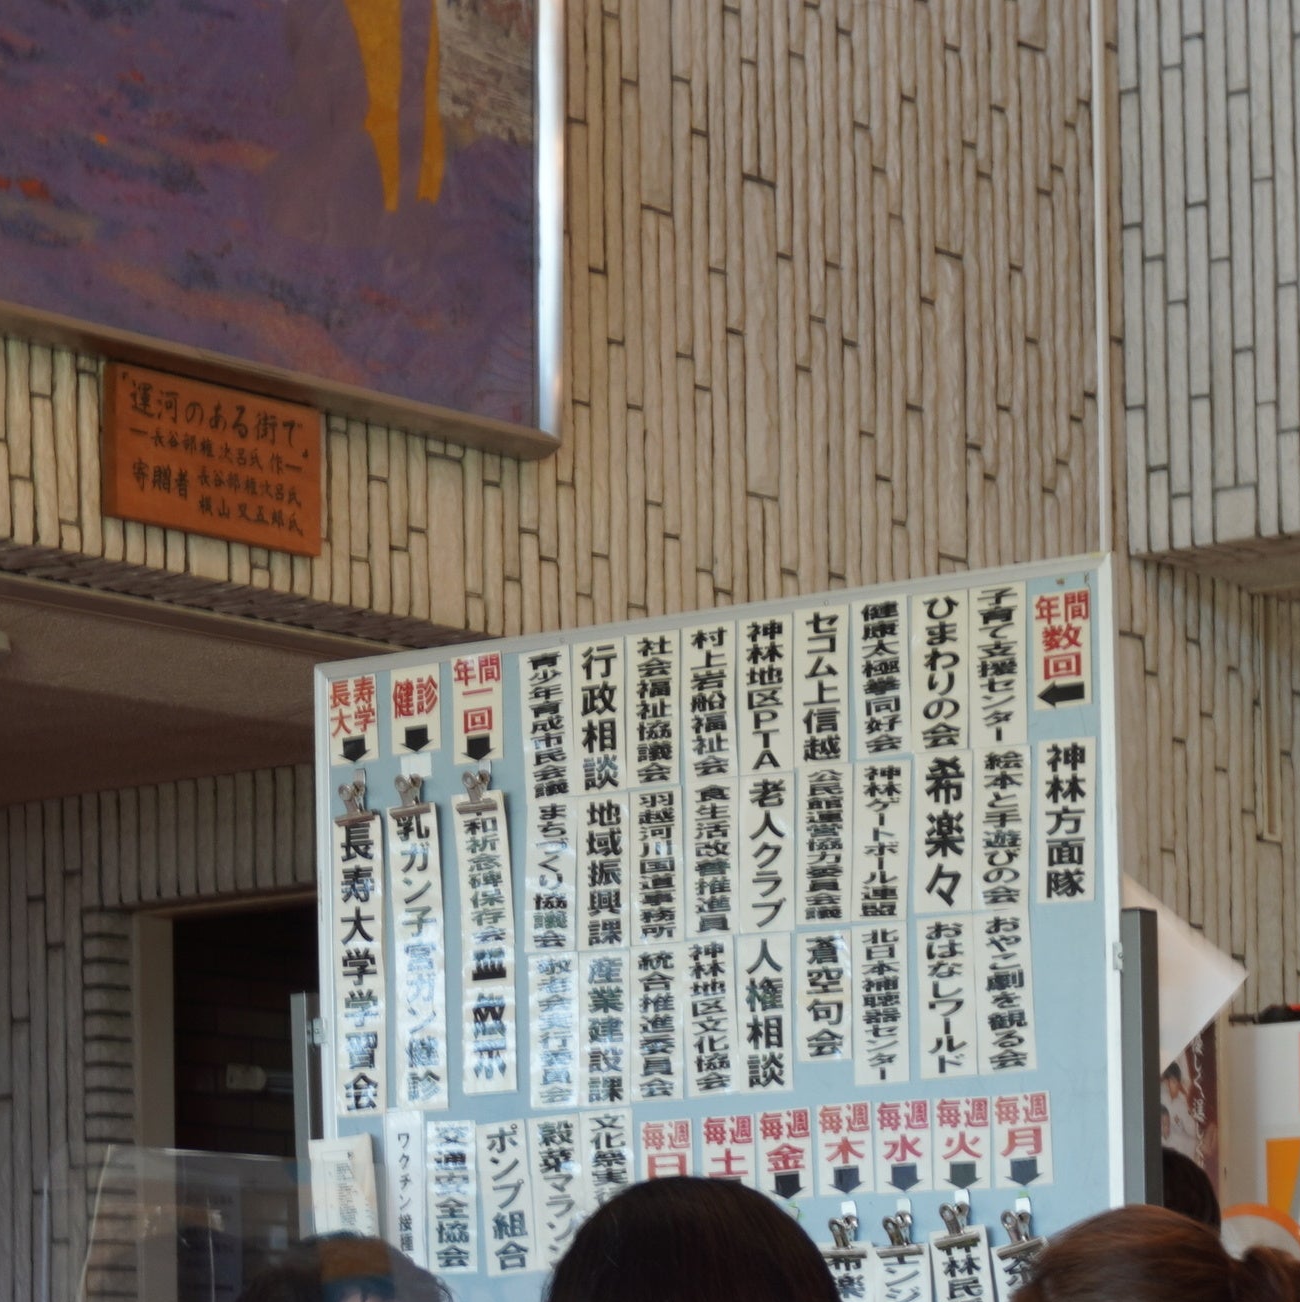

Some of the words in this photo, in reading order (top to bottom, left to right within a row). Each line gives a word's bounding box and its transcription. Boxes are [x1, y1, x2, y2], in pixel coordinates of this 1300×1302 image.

[392, 675, 438, 719] 健診
[528, 651, 569, 798] 青少年育成市民会議
[581, 644, 619, 790] 行政相談
[636, 636, 672, 783] 社会福祉協議会
[690, 627, 729, 777] 村上岩船福祉会
[747, 619, 783, 770] 神林地区PTA
[803, 612, 841, 762] セコム上信越
[861, 601, 902, 753] 健康太極拳同好会
[921, 596, 960, 749] ひまわりの会
[977, 587, 1018, 741] 子育て支援センター
[533, 804, 568, 948] まちづくり協議会
[587, 800, 622, 946] 地域振興課
[639, 791, 675, 938] 羽越河川国道事務所
[695, 784, 731, 933] 食生活改善推進員
[749, 778, 787, 927] 老人クラブ
[861, 765, 902, 917] 神林ゲートボール連盟
[925, 755, 965, 907] 希楽々
[982, 751, 1023, 904] 絵本と手遊びの会
[1046, 742, 1086, 898] 神林方面隊
[587, 956, 623, 1103] 産業建設課
[638, 951, 675, 1098] 統合推進委員会
[689, 941, 731, 1092] 神林地区文化協会
[746, 939, 785, 1088] 人権相談
[806, 935, 845, 1057] 蒼空句会
[861, 928, 900, 1080] 北日本補聴器センター
[925, 921, 967, 1074] おはなしワールド
[986, 916, 1028, 1070] おやこ劇を観る会
[487, 1125, 528, 1270] ポンプ組合
